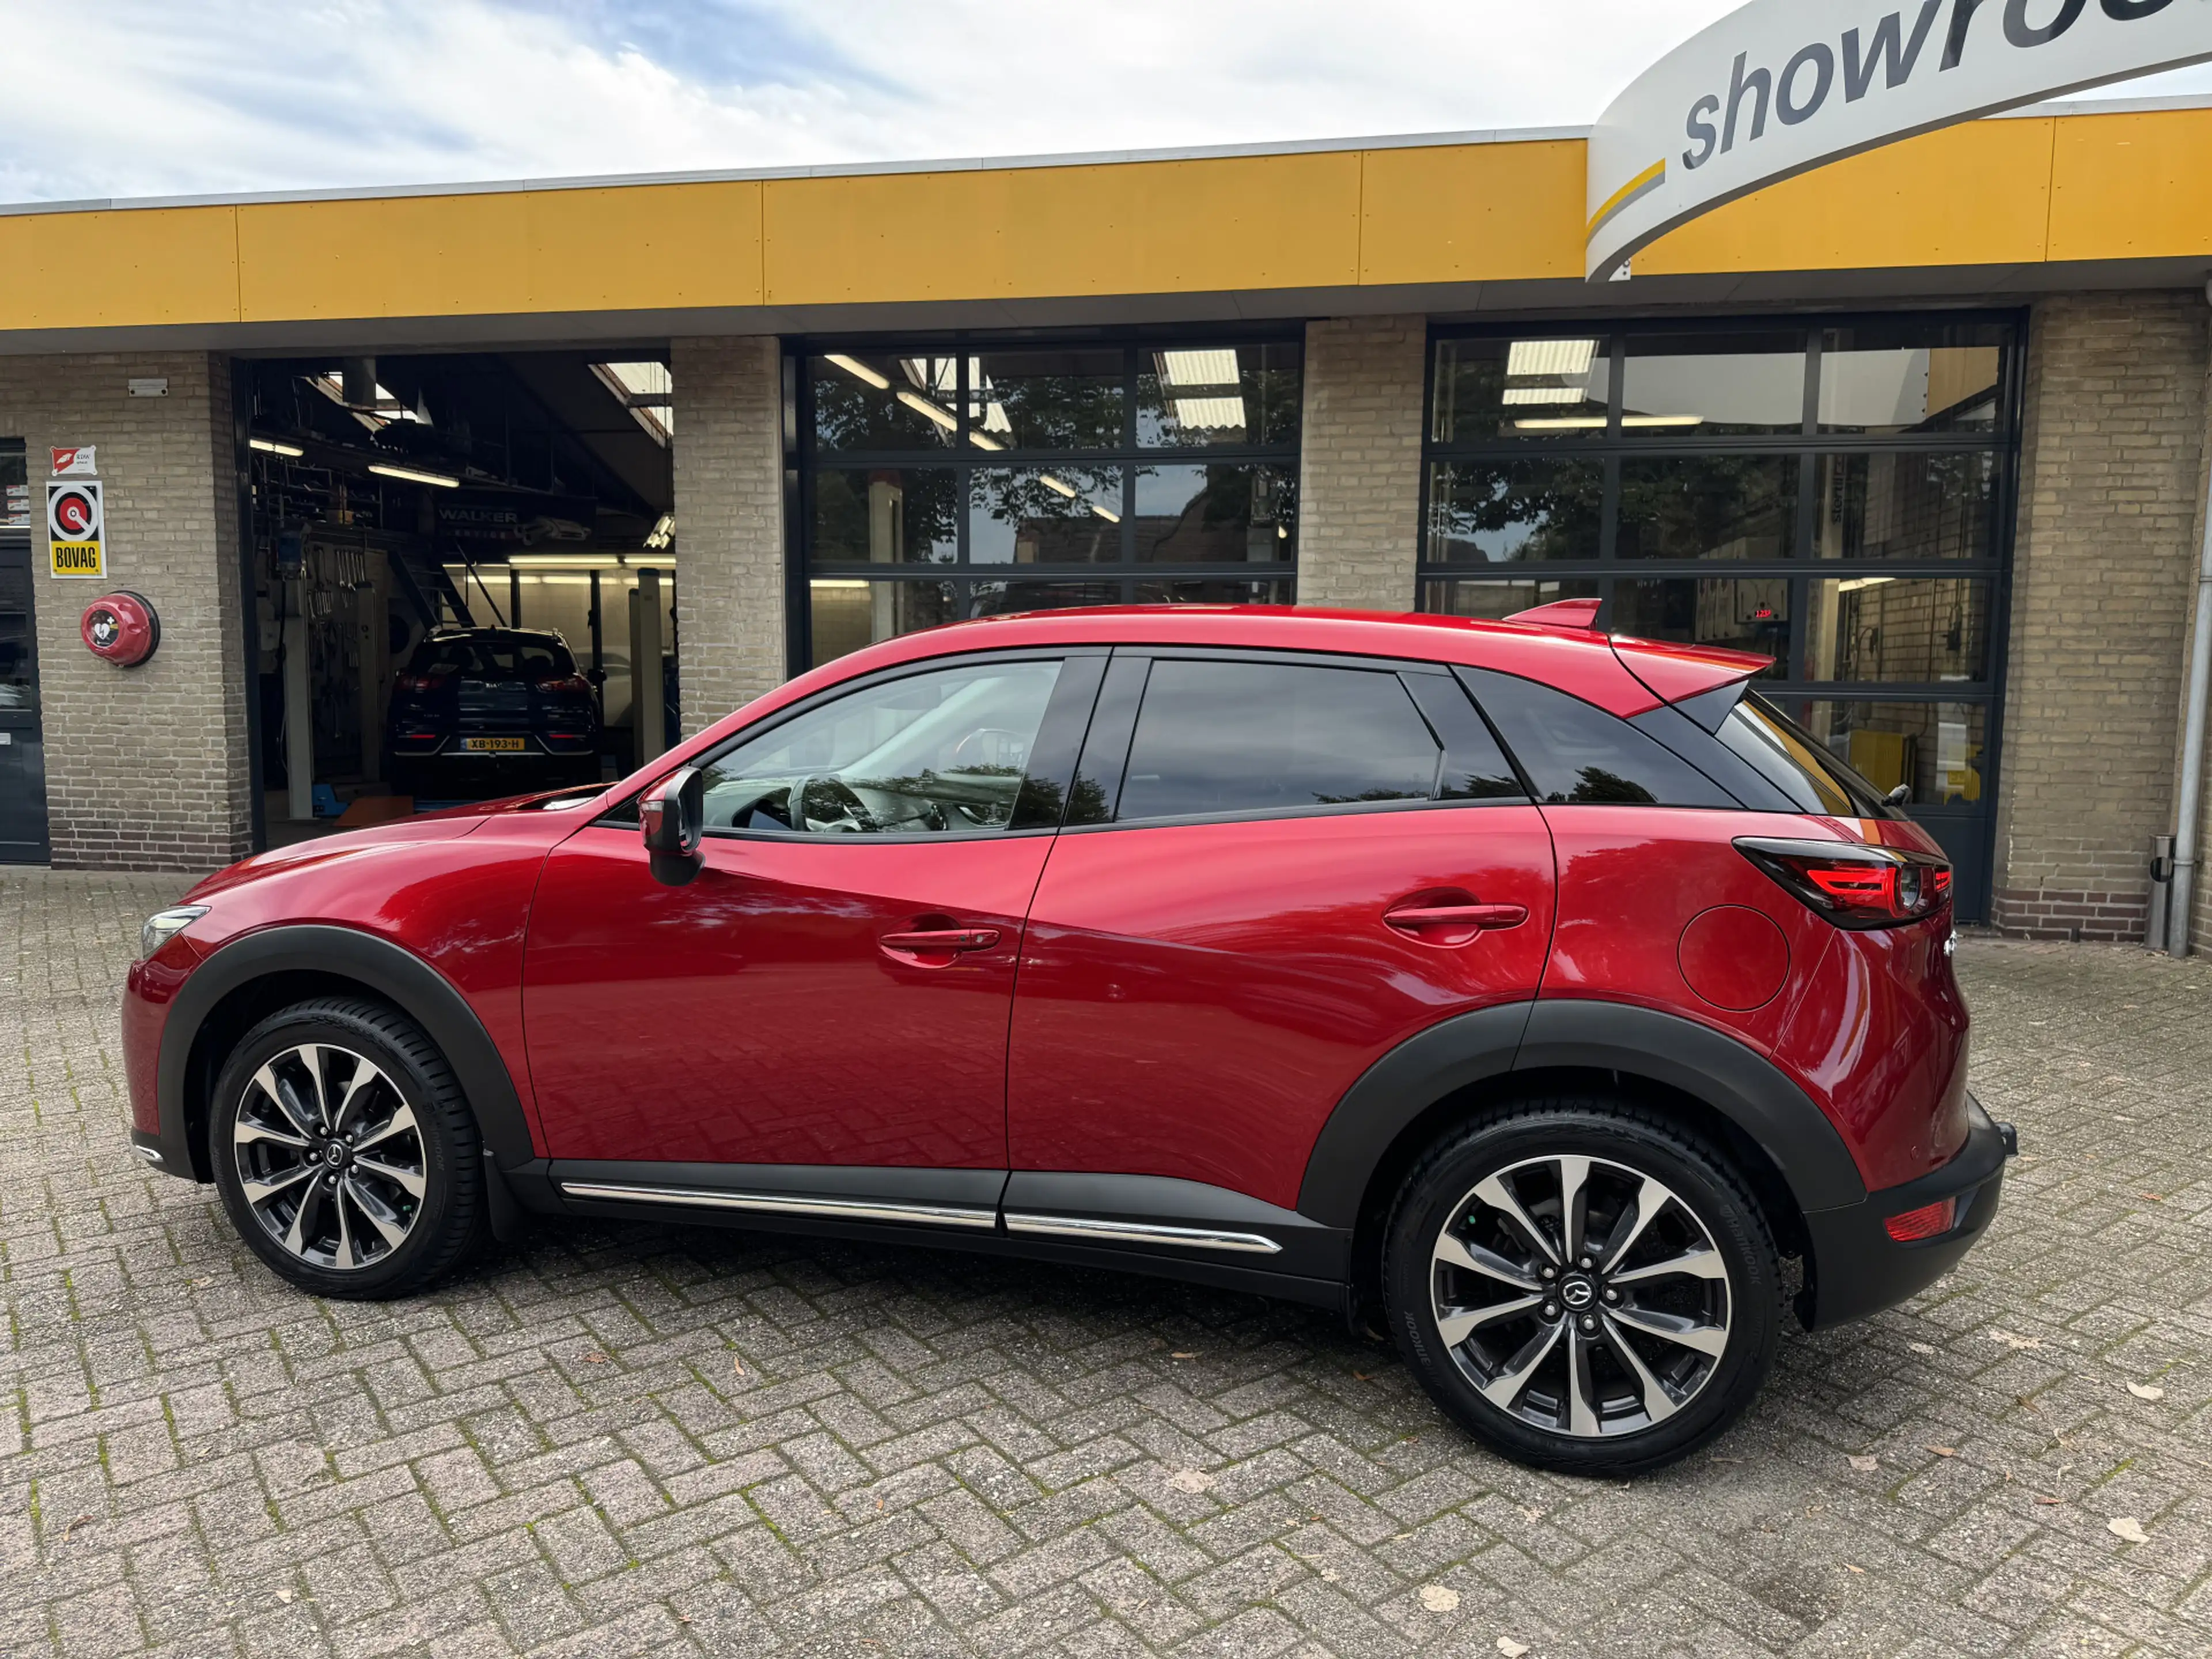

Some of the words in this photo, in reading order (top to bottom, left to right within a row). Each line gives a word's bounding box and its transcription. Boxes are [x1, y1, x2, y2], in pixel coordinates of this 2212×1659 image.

[1682, 0, 2173, 171] showro
[438, 509, 517, 523] WALKER
[55, 547, 97, 569] BOVAG
[471, 740, 519, 748] XB-193-H
